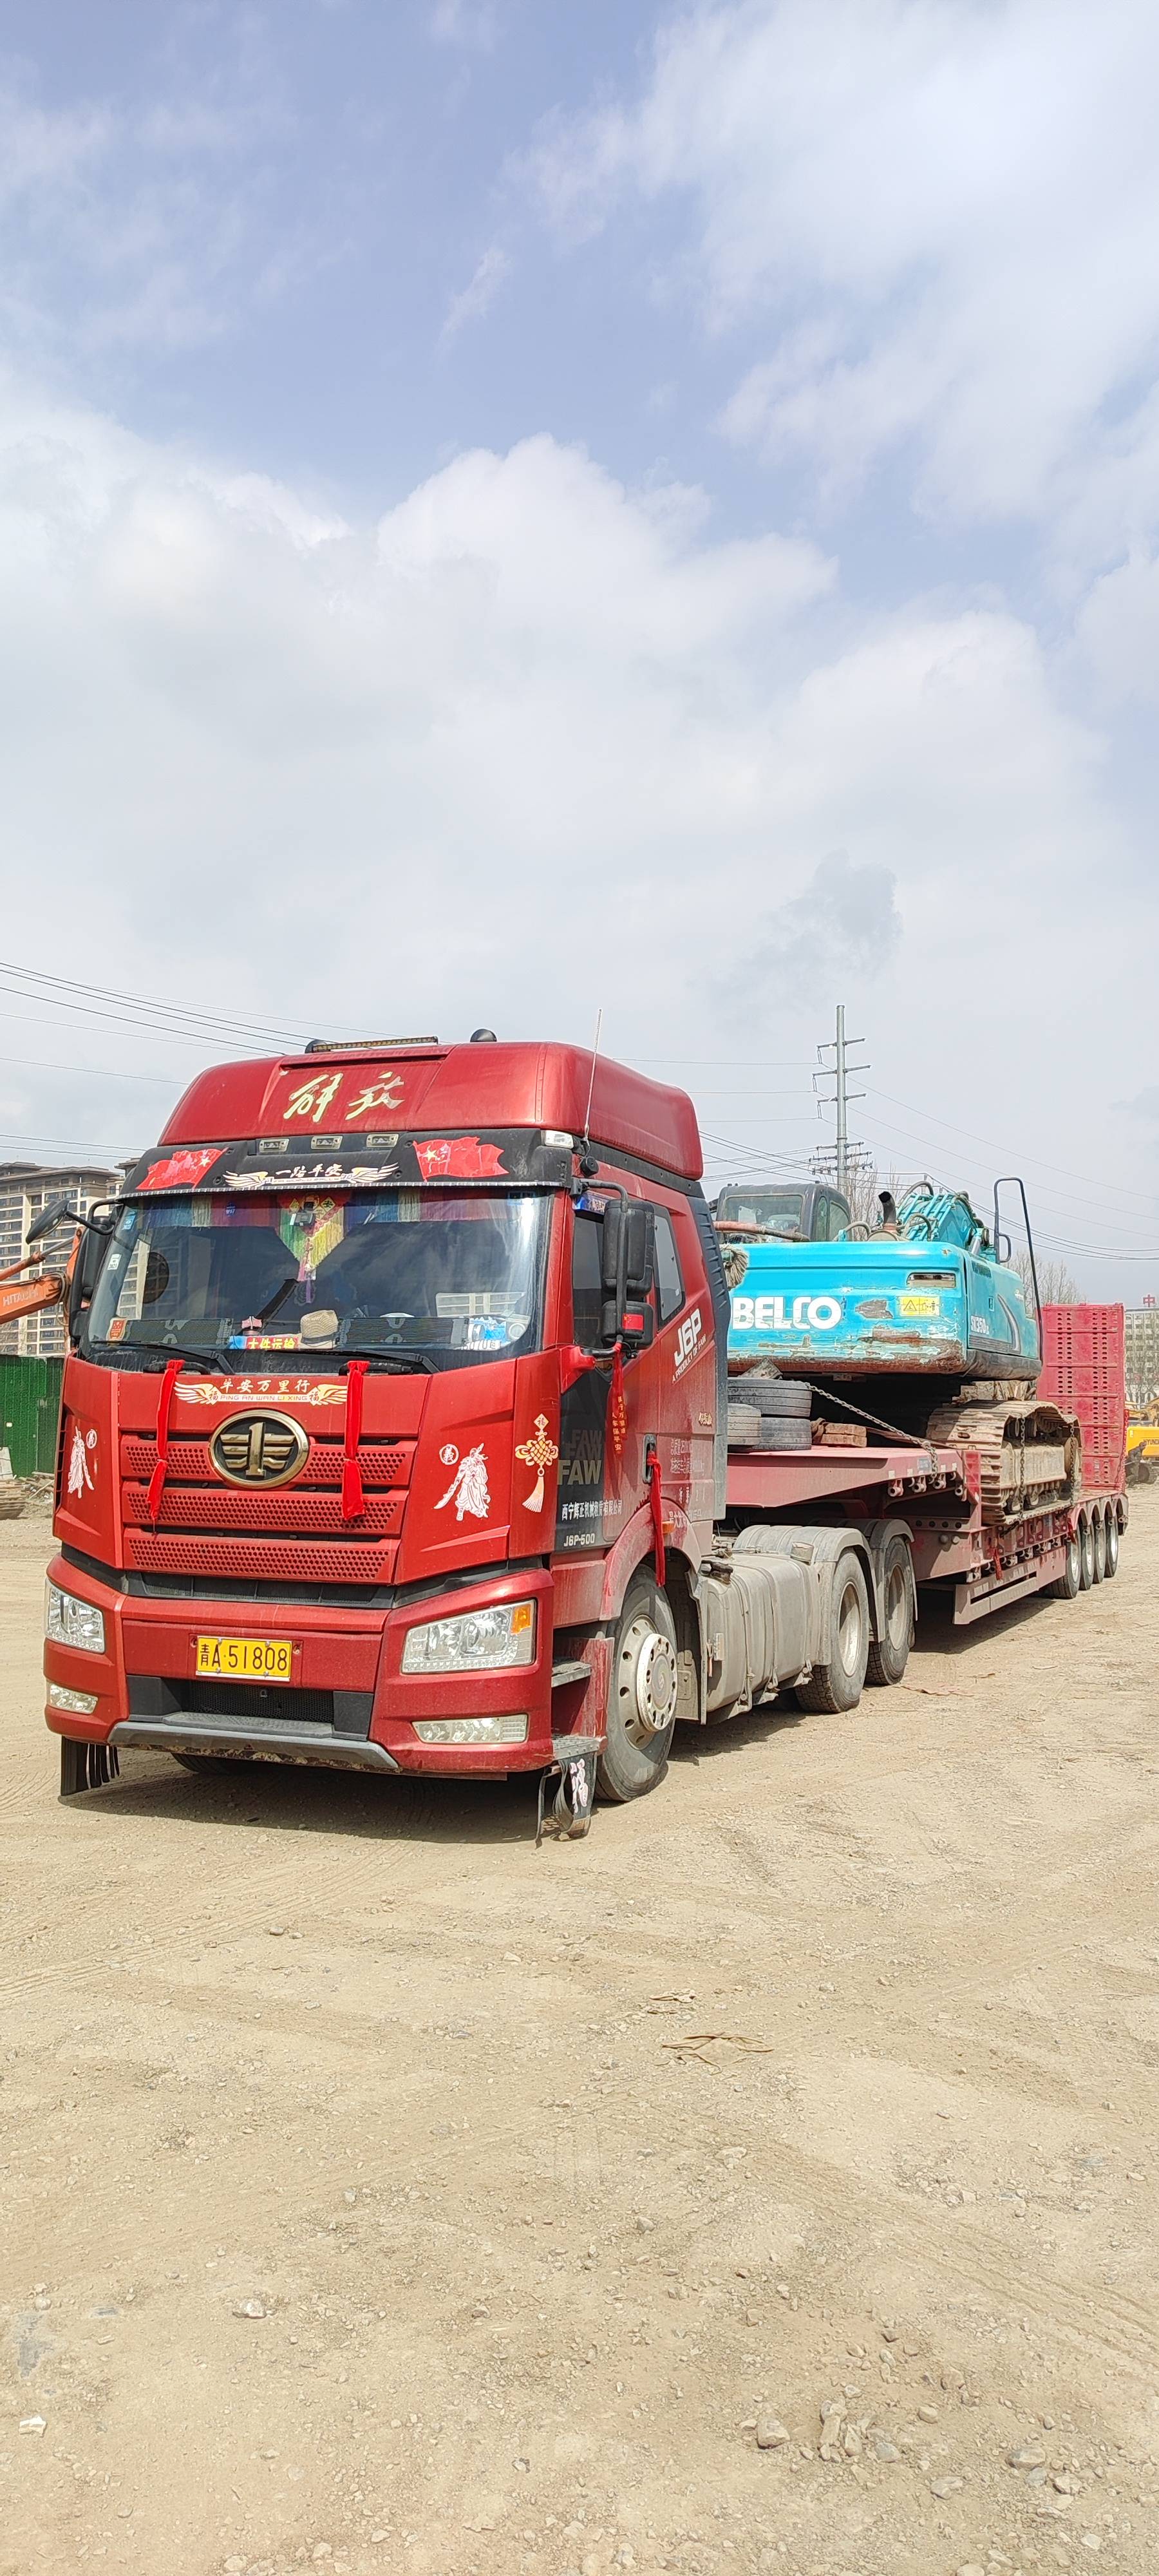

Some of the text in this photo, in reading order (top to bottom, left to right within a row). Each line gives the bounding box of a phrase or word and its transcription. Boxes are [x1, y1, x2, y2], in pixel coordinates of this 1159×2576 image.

[283, 1072, 405, 1122] 解放
[276, 1164, 343, 1178] 一路平安
[733, 1296, 842, 1330] BELCO
[674, 1308, 702, 1367] J6P
[220, 1378, 310, 1394] 平安万里行
[309, 1390, 319, 1401] 福
[557, 1459, 602, 1485] FAW
[564, 1533, 596, 1547] J6P-500
